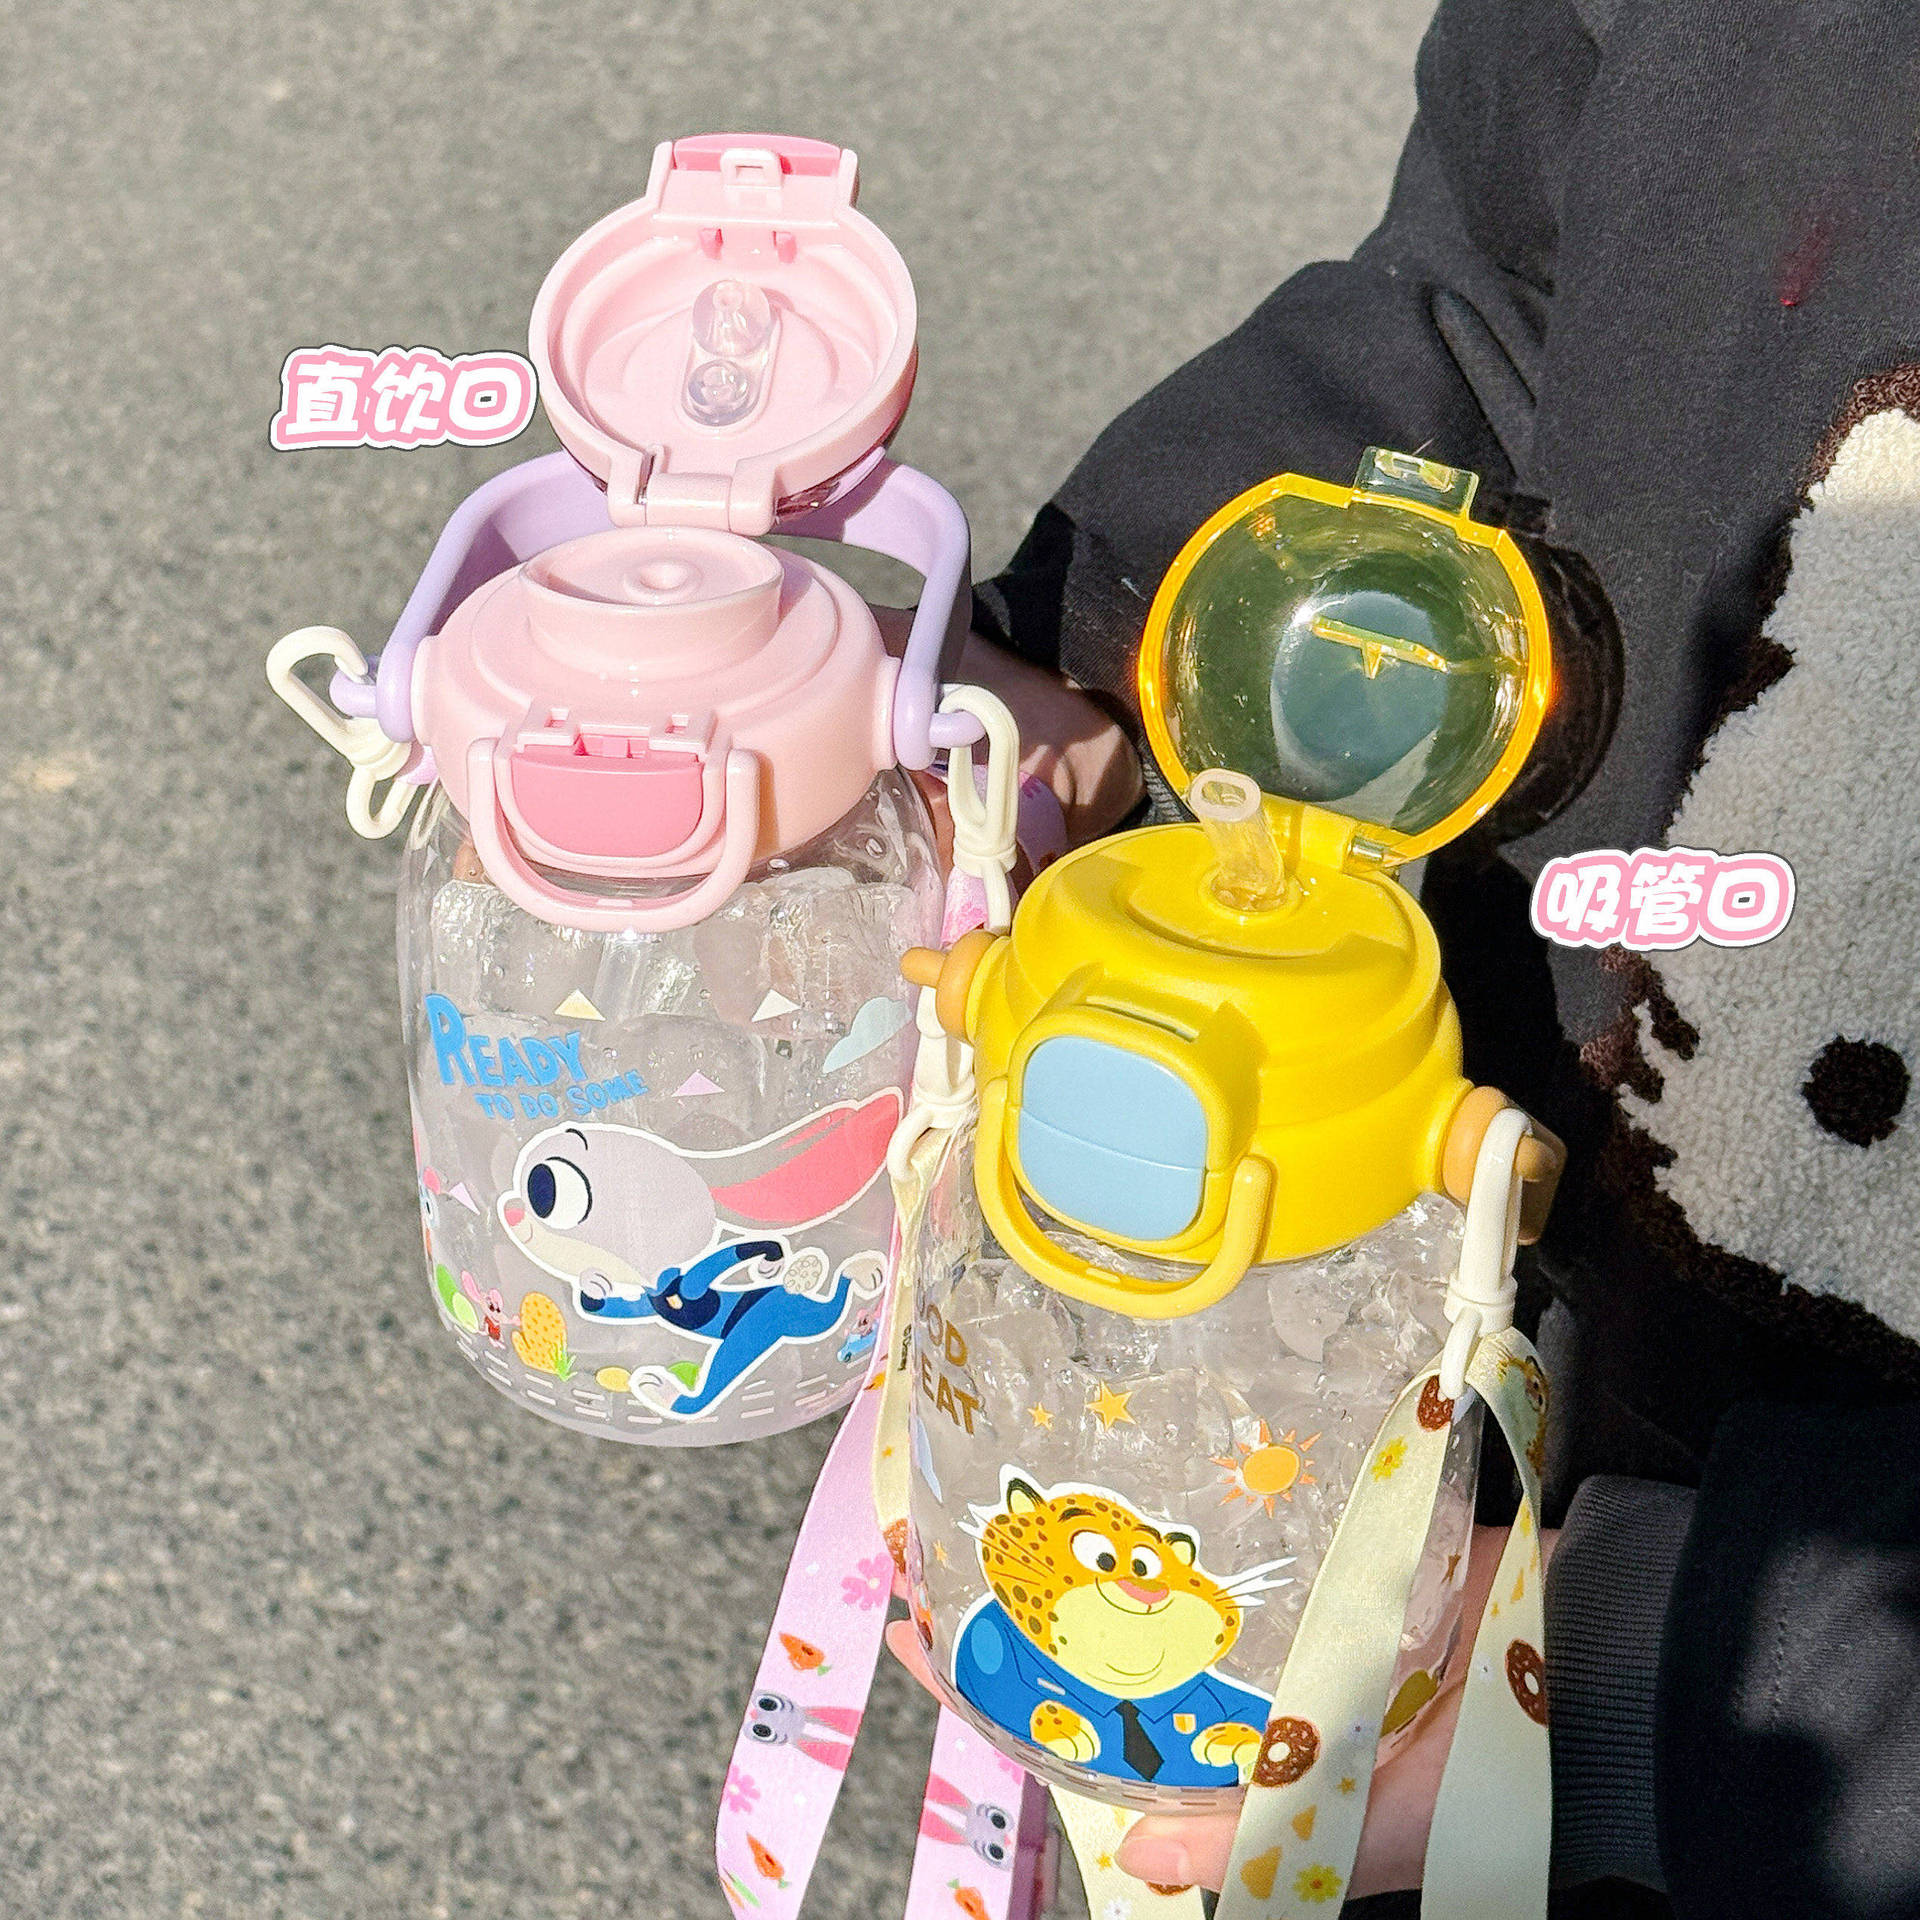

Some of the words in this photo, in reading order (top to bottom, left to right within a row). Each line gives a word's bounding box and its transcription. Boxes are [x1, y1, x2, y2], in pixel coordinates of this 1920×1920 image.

[424, 992, 588, 1087] READY
[474, 1093, 515, 1120] TO
[519, 1092, 559, 1120] DO
[566, 1069, 649, 1116] SOME
